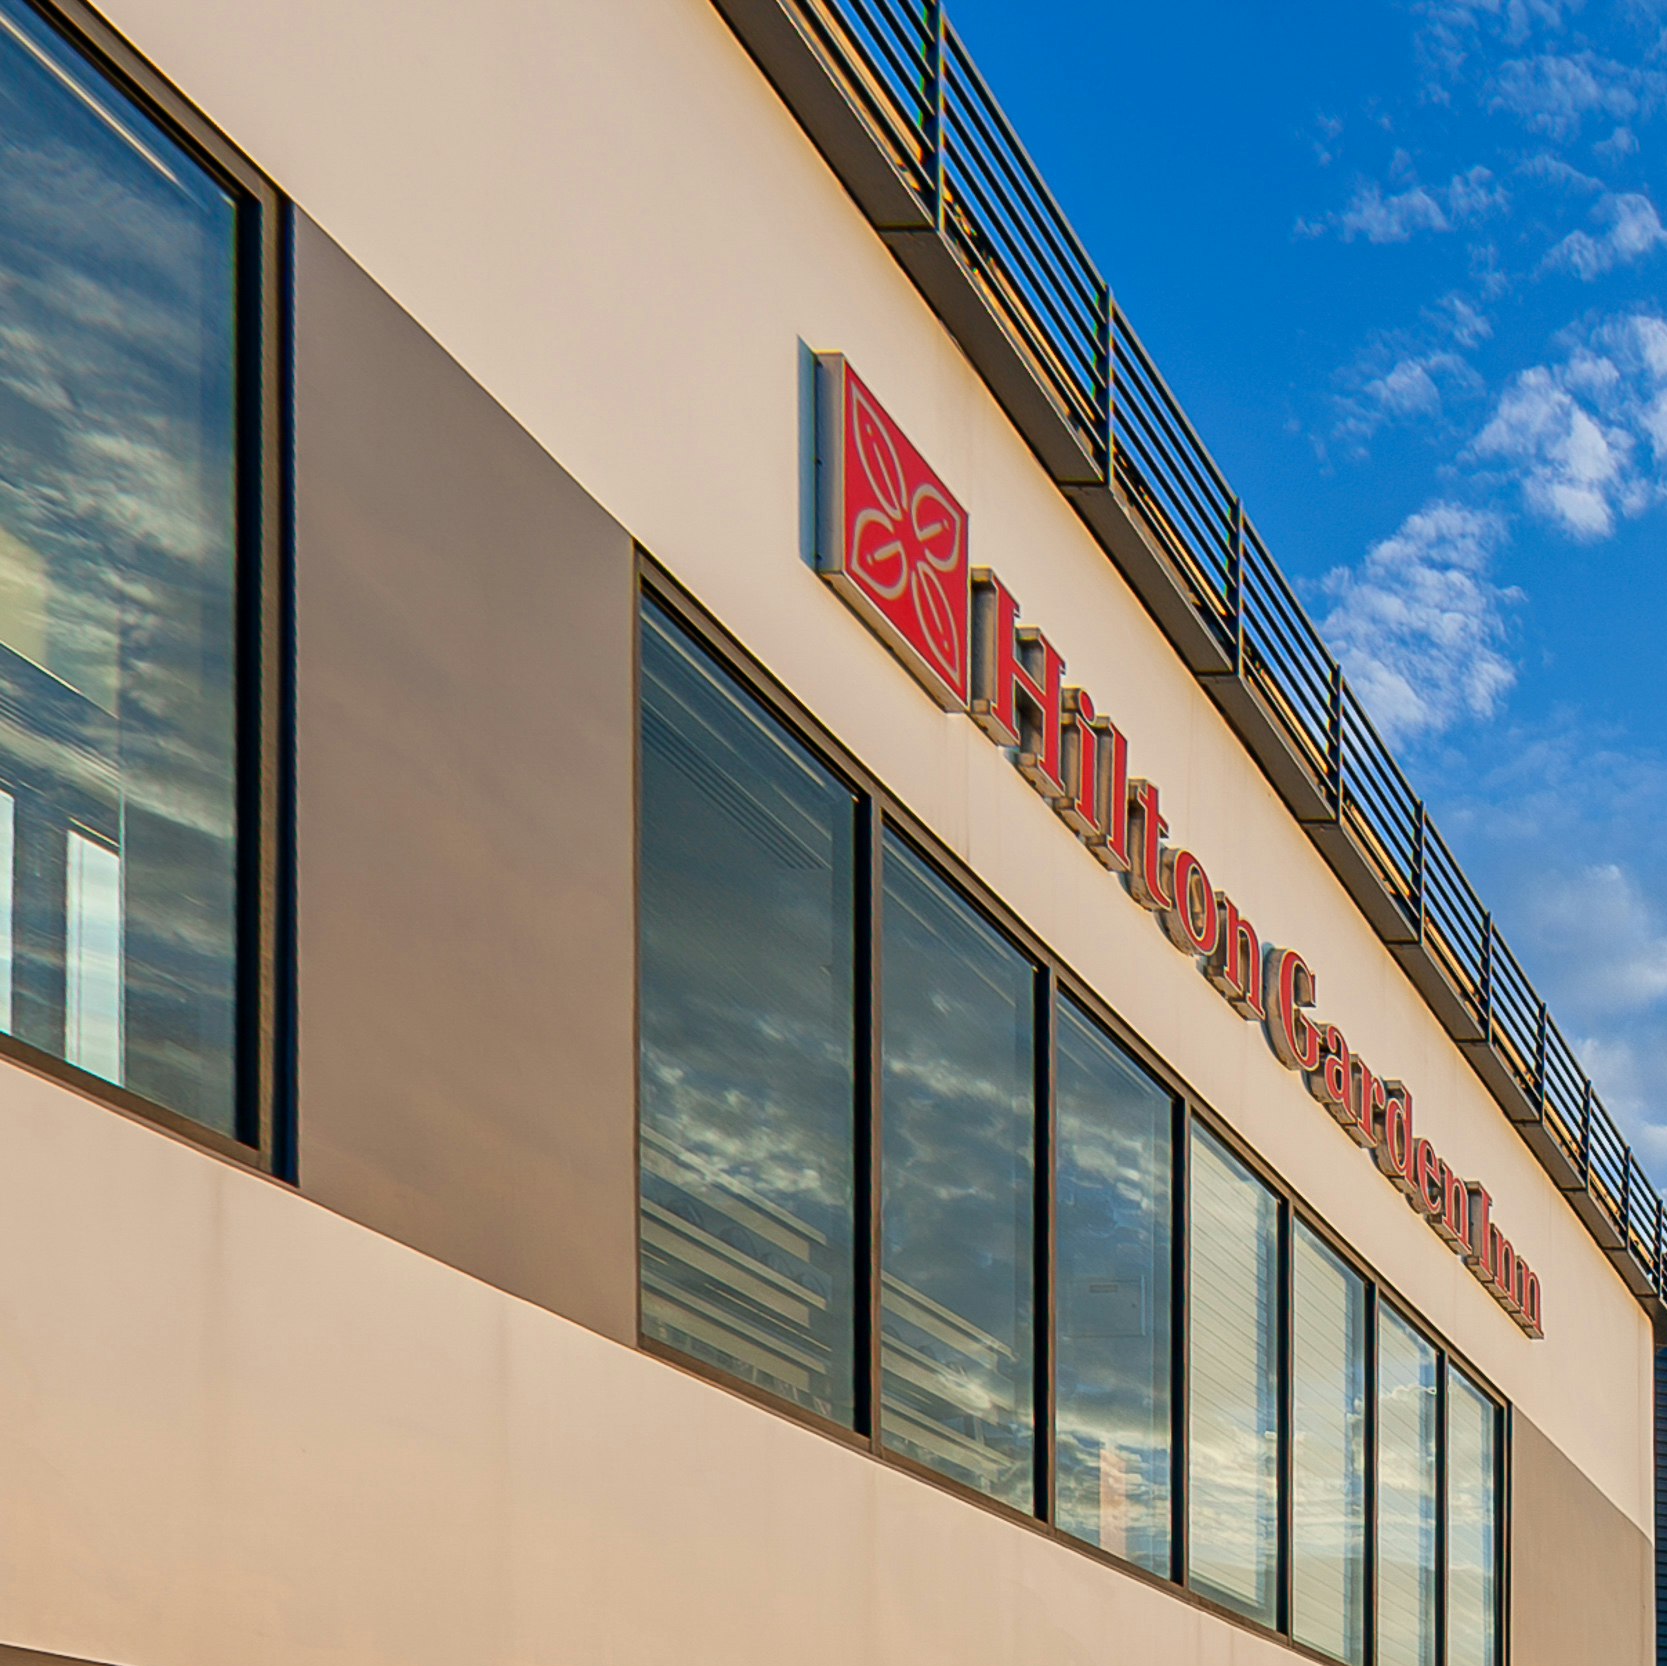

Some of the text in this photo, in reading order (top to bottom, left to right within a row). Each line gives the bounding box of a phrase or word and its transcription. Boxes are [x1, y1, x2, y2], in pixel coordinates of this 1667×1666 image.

[985, 572, 1544, 1339] Hilton Garden Inn
